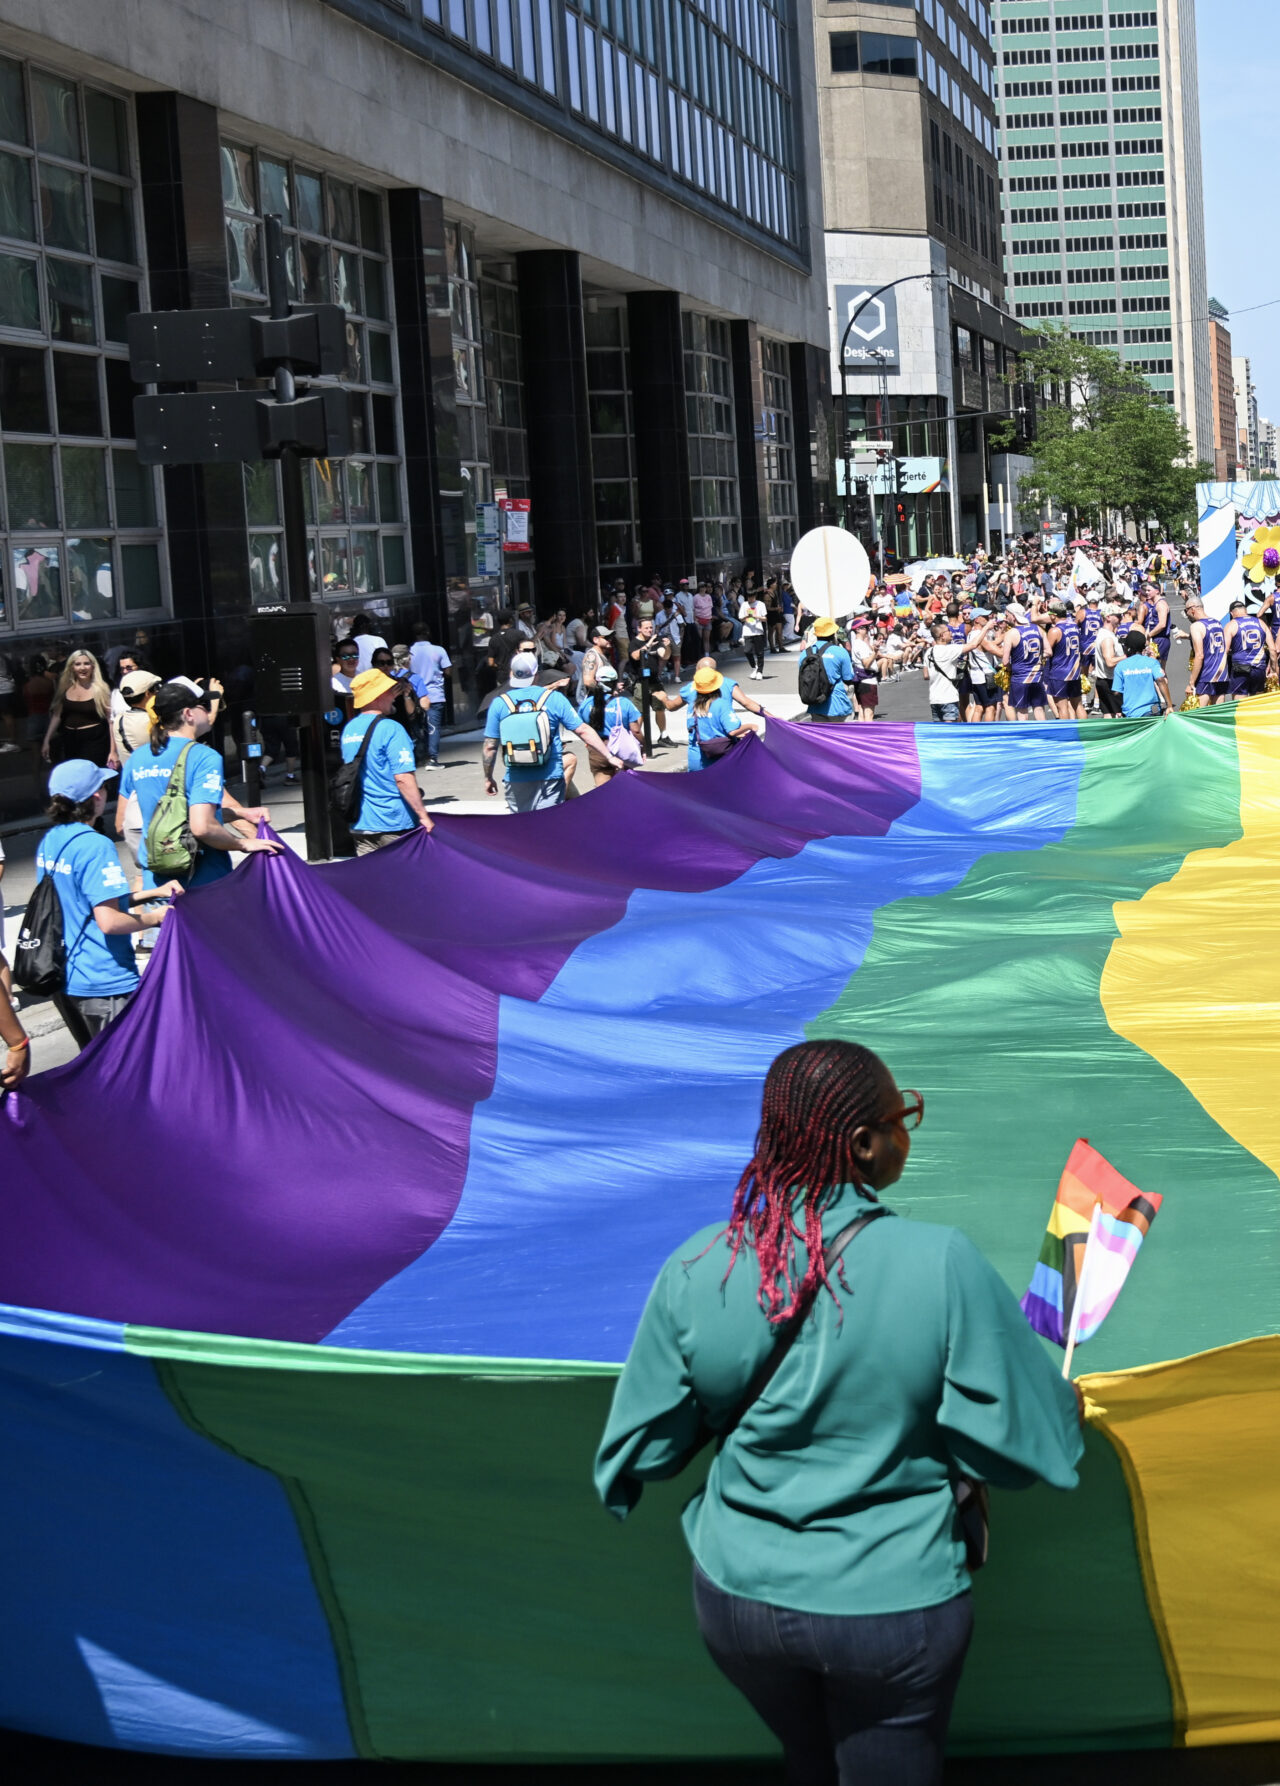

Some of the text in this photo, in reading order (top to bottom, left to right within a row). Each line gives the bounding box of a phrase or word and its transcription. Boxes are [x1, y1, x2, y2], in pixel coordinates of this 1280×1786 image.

[1023, 638, 1041, 660] 19
[1065, 635, 1080, 656] 19
[1209, 631, 1225, 655] 19
[1241, 628, 1262, 651] 19
